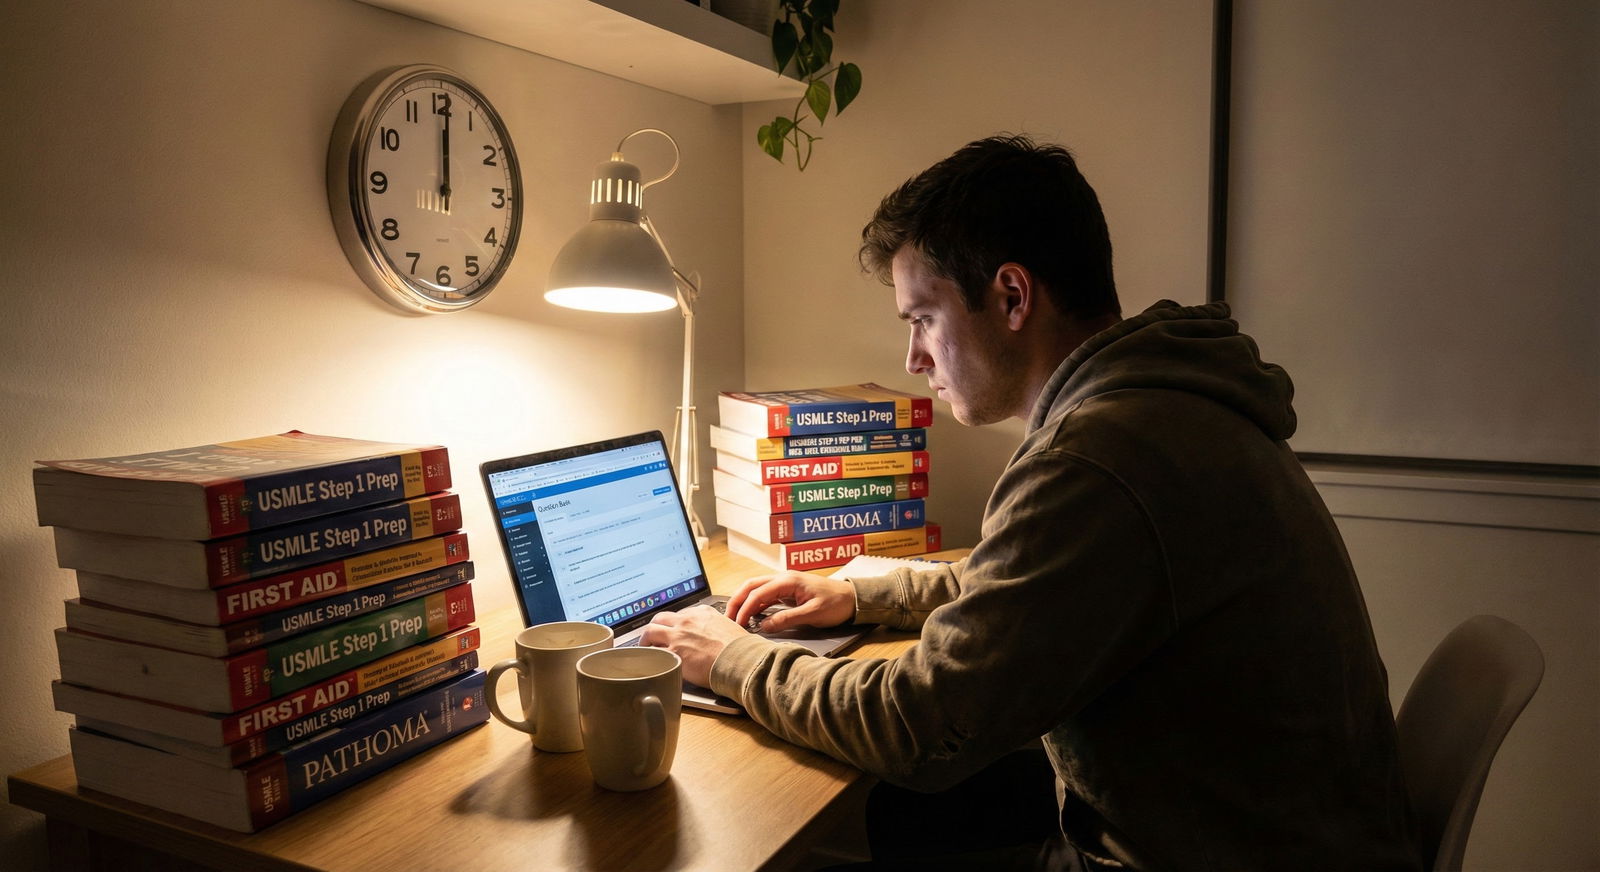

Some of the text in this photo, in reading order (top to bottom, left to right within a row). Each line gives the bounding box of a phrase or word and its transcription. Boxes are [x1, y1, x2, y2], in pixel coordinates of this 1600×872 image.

[406, 99, 418, 124] 11
[432, 92, 452, 118] 12
[468, 110, 473, 132] 1
[380, 127, 400, 152] 10
[483, 144, 497, 167] 2
[370, 171, 388, 194] 9
[491, 187, 505, 209] 3
[380, 218, 400, 241] 8
[484, 227, 498, 248] 4
[406, 252, 421, 275] 7
[465, 255, 480, 277] 5
[436, 265, 451, 287] 6
[796, 413, 835, 426] USMLE
[836, 411, 860, 426] Step
[861, 410, 868, 422] 1
[869, 408, 893, 423] Prep
[766, 464, 810, 480] FIRST
[812, 463, 839, 476] AID
[257, 482, 317, 512] USMLE
[319, 478, 354, 502] Step
[356, 475, 365, 493] 1
[367, 472, 399, 491] Prep
[798, 488, 836, 504] USMLE
[837, 486, 861, 501] Step
[862, 486, 868, 497] 1
[869, 484, 893, 499] Prep
[803, 512, 882, 533] PATHOMA
[260, 533, 321, 563] USMLE
[324, 527, 360, 549] Step
[362, 522, 372, 540] 1
[374, 518, 407, 539] Prep
[790, 547, 833, 565] FIRST
[836, 544, 862, 559] AID
[226, 571, 338, 616] FIRST AID
[282, 593, 386, 632] USMLE Step 1 Prep
[282, 640, 340, 677] USMLE
[343, 629, 378, 655] Step
[381, 622, 390, 642] 1
[392, 615, 423, 636] Prep
[239, 681, 351, 737] FIRST AID
[286, 692, 391, 741] USMLE Step 1 Prep
[303, 712, 431, 789] PATHOMA
[262, 775, 273, 813] USMLE
